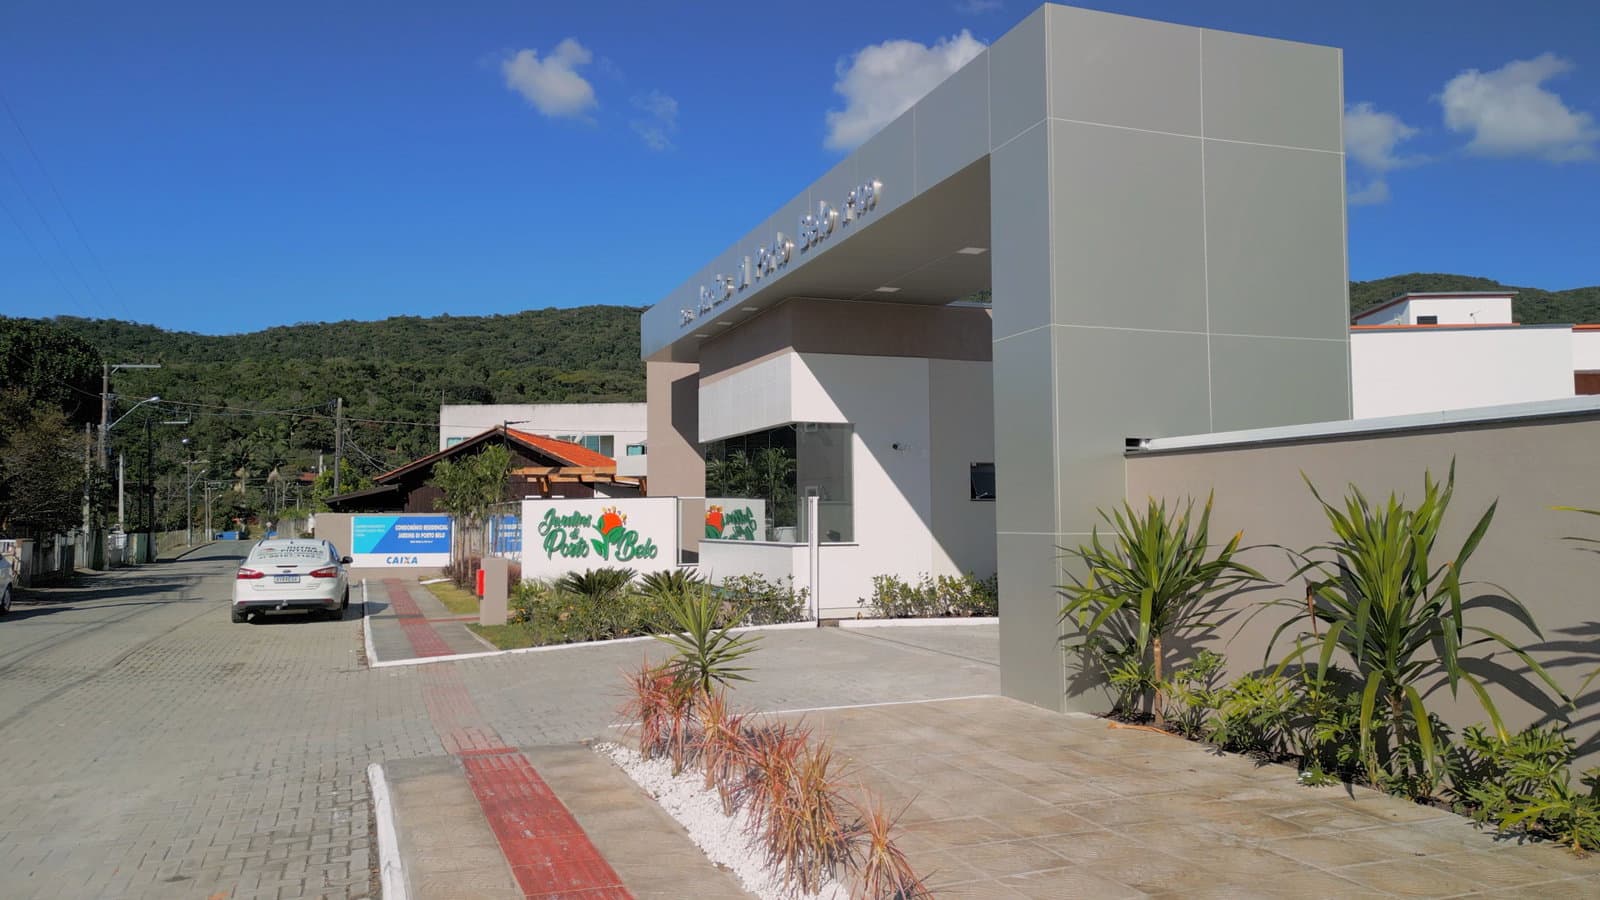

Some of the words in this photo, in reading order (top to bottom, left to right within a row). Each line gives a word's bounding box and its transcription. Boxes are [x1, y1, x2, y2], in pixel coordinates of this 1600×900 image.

[543, 528, 589, 560] Porto
[615, 530, 658, 561] Belo
[386, 556, 418, 565] CAIXA
